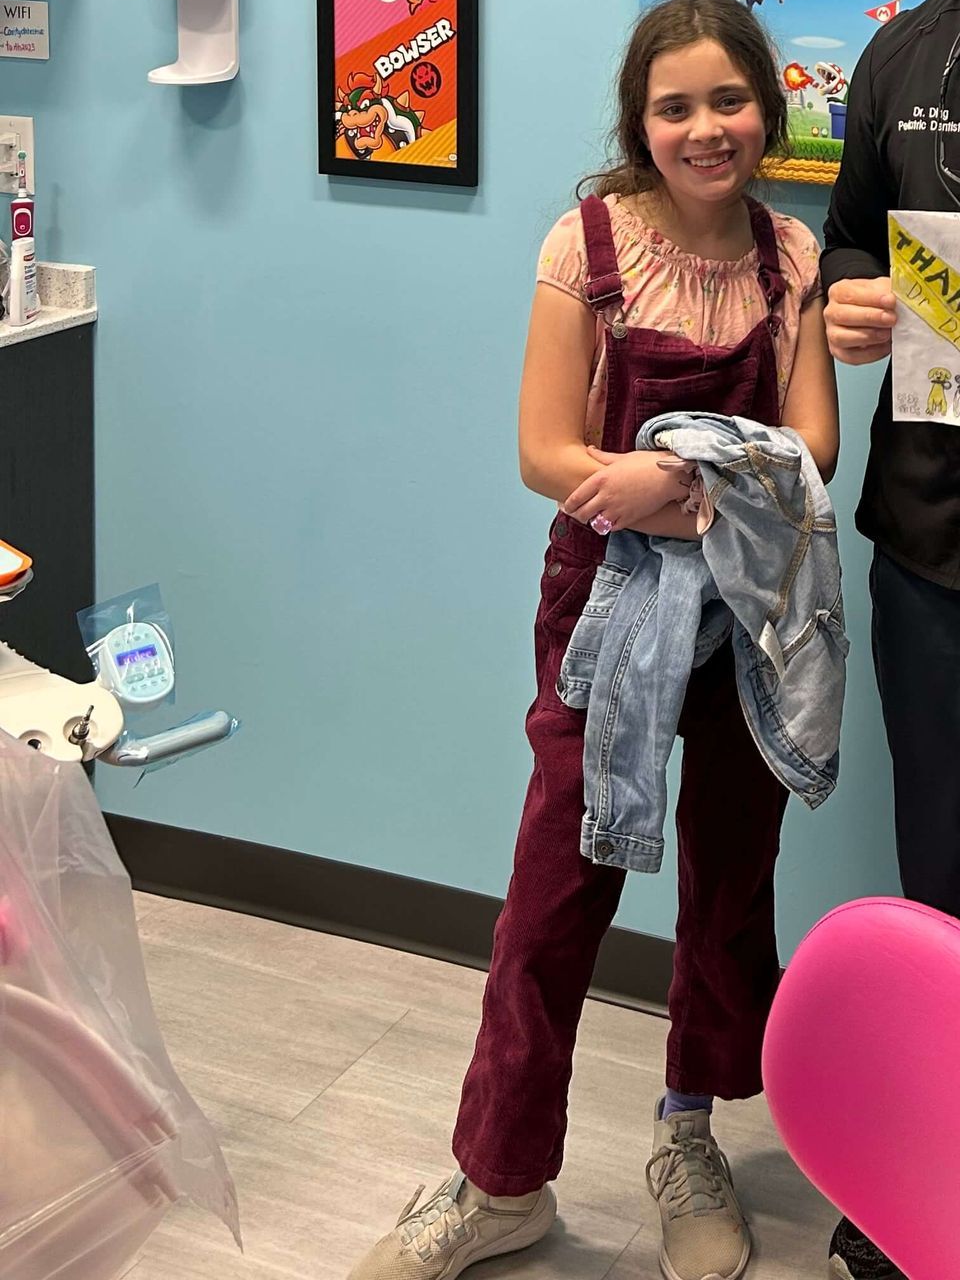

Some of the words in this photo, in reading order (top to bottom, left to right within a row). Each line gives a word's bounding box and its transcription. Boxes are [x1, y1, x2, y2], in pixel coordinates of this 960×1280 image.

[4, 5, 31, 19] WIFI
[373, 17, 457, 80] BOWSER
[913, 106, 926, 117] Dr.
[907, 281, 930, 306] Dr
